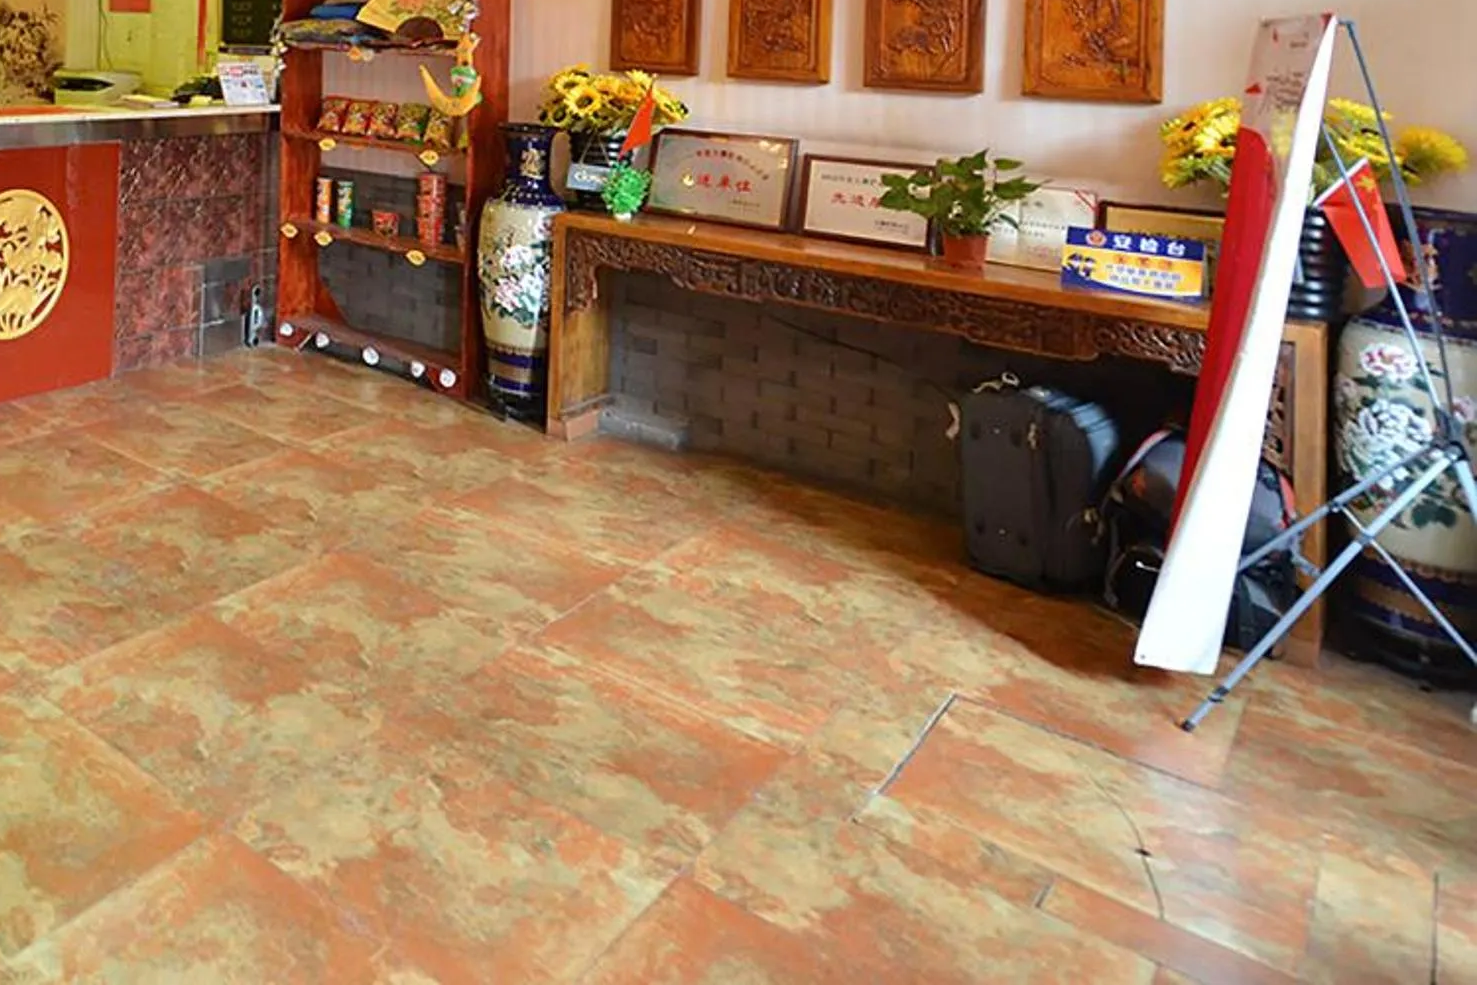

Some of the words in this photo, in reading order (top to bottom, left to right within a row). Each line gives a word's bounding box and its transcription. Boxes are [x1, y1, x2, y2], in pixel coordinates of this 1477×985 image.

[681, 172, 752, 193] 进单位
[1113, 233, 1186, 256] 安检台
